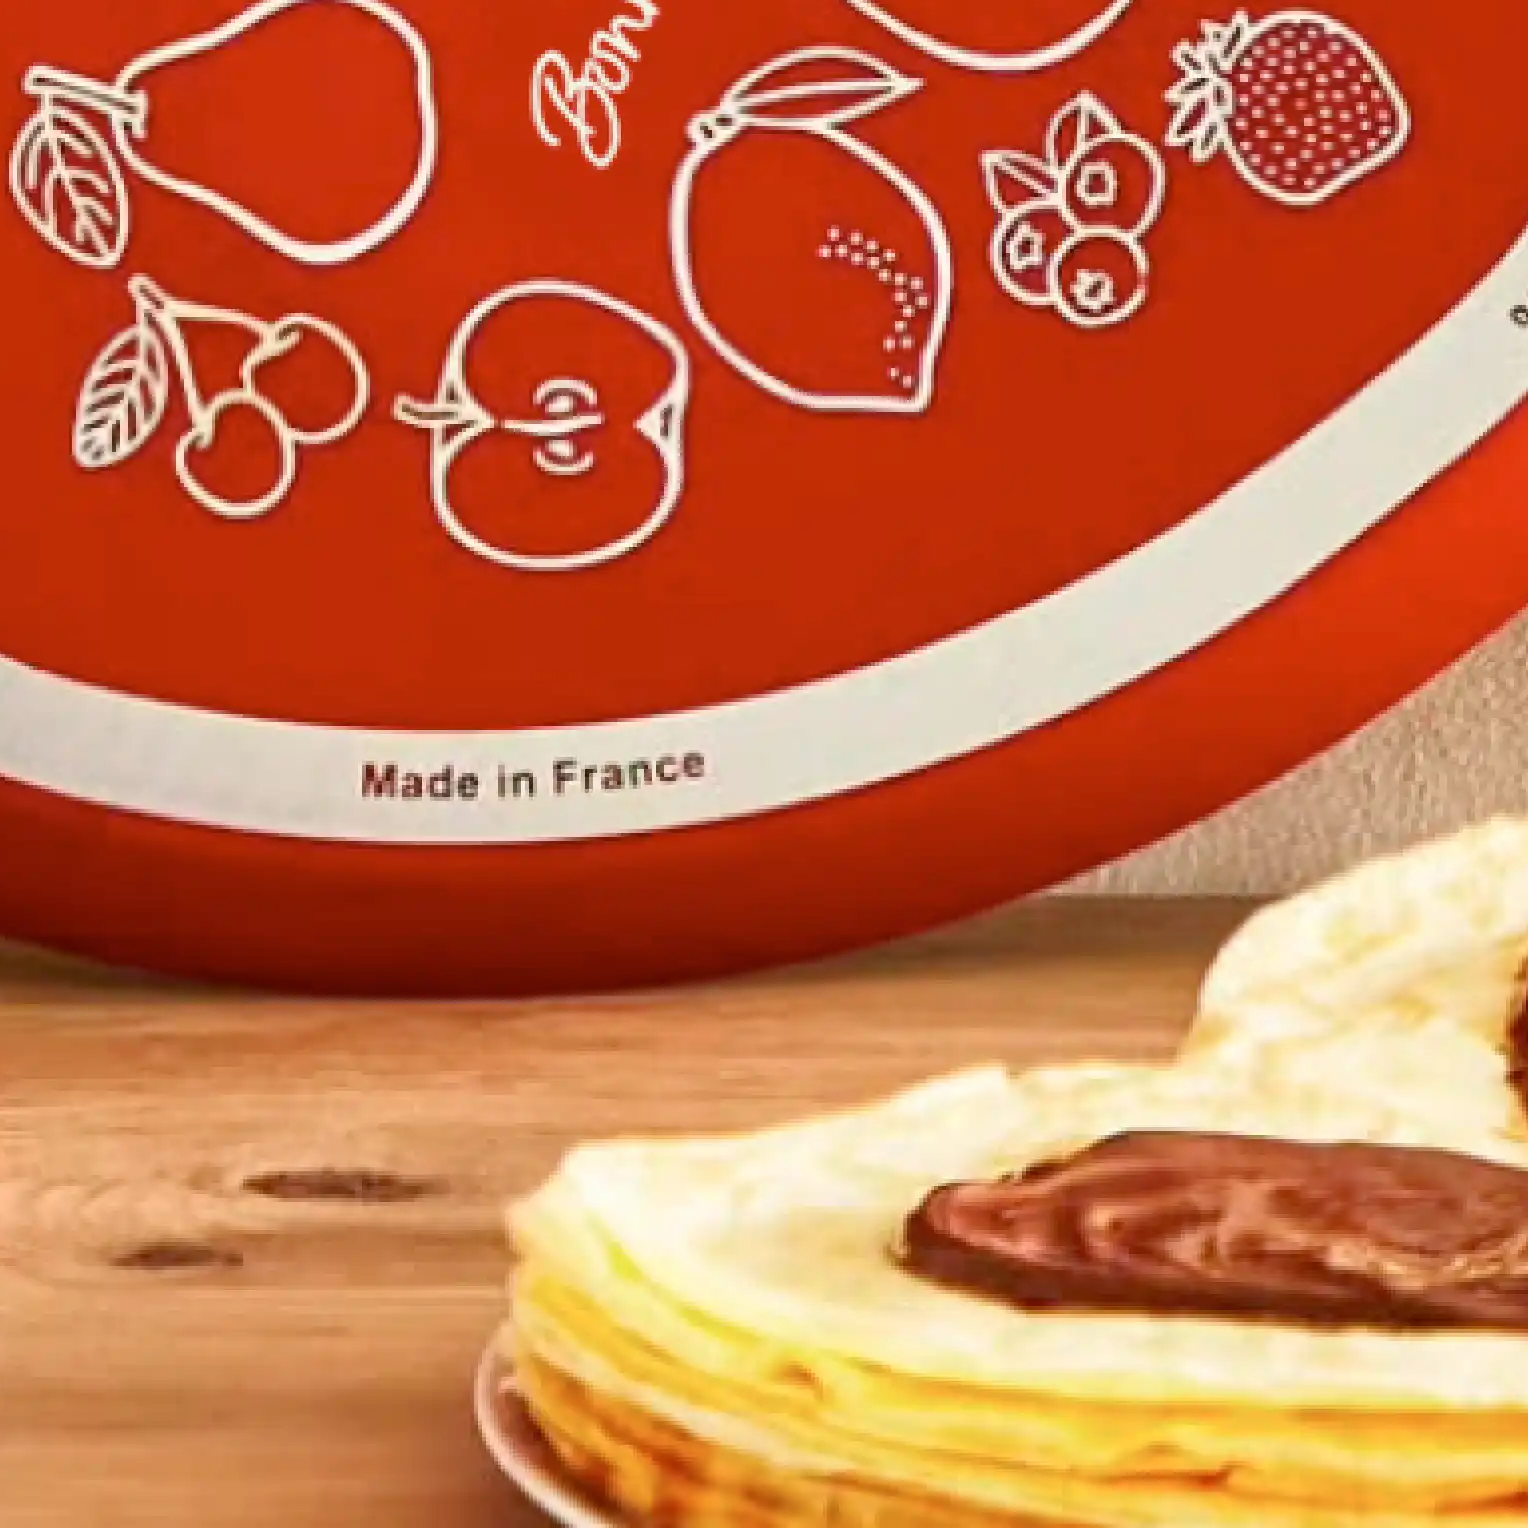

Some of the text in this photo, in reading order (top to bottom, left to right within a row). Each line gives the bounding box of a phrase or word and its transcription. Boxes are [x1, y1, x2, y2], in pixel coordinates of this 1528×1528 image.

[360, 750, 706, 801] Made in France
